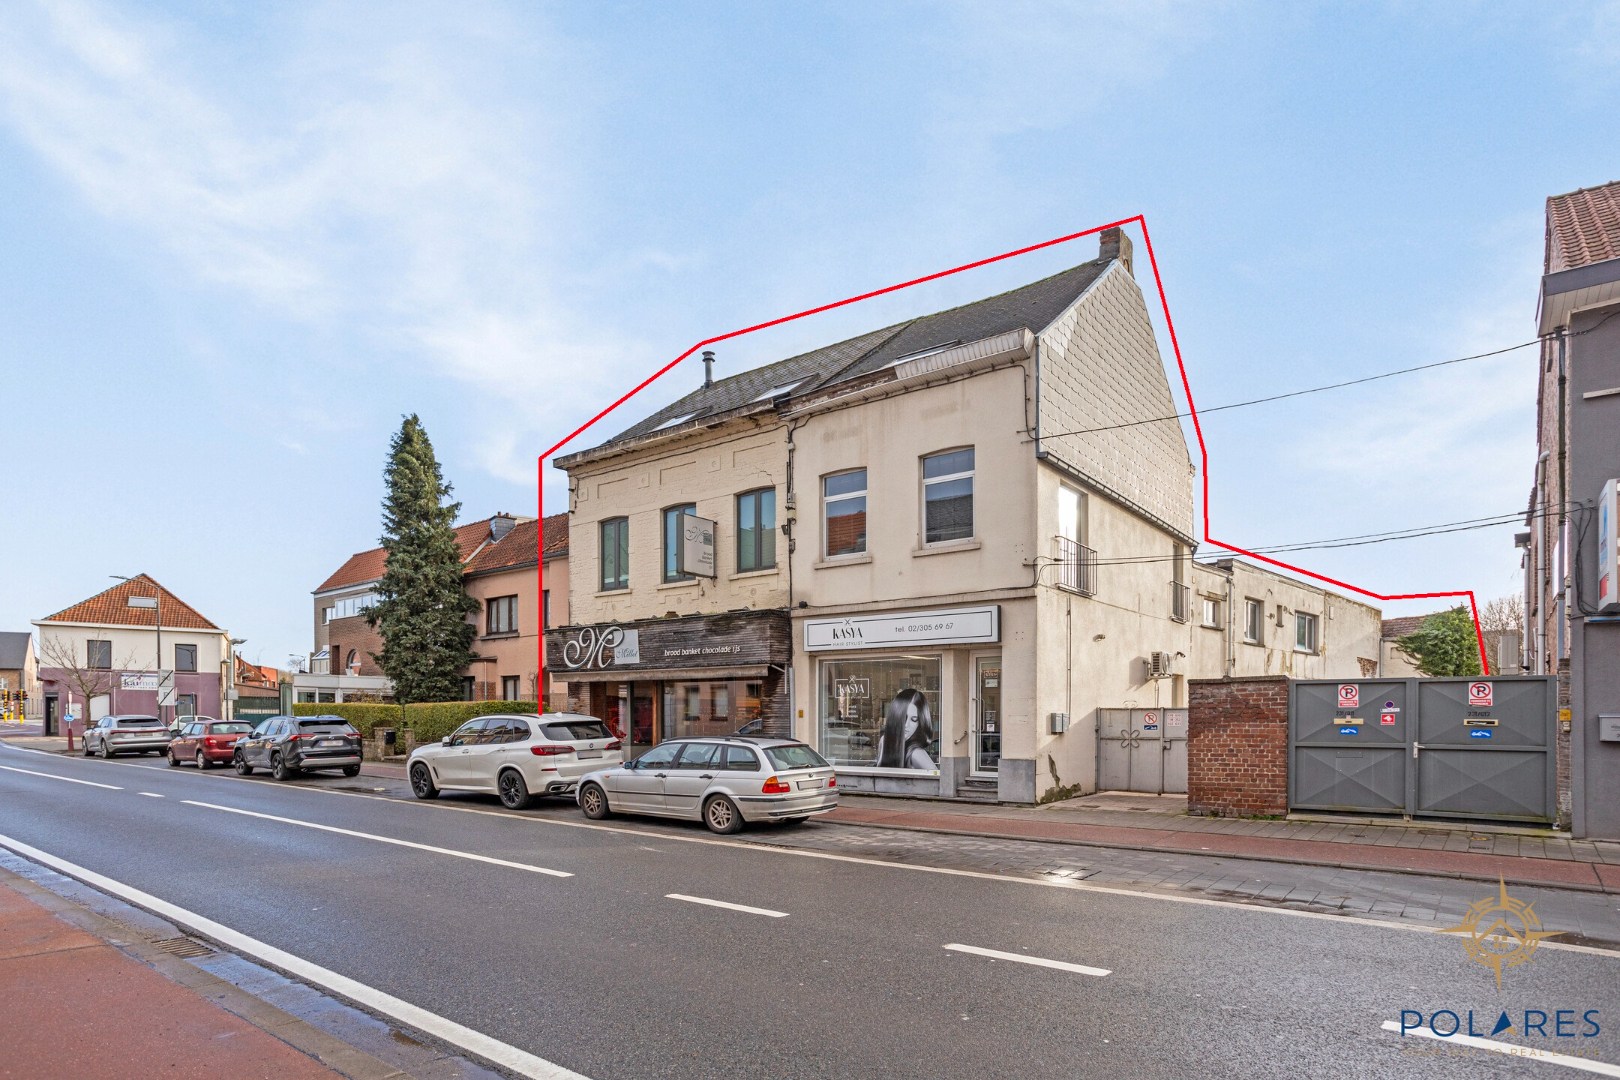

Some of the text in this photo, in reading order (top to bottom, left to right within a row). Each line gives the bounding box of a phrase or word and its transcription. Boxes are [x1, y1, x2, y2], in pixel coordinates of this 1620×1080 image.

[832, 627, 863, 639] KASYA
[908, 624, 932, 633] 02/305
[945, 622, 954, 630] 67
[664, 644, 741, 657] brood banket chocolade ijs
[839, 683, 865, 693] KASYA
